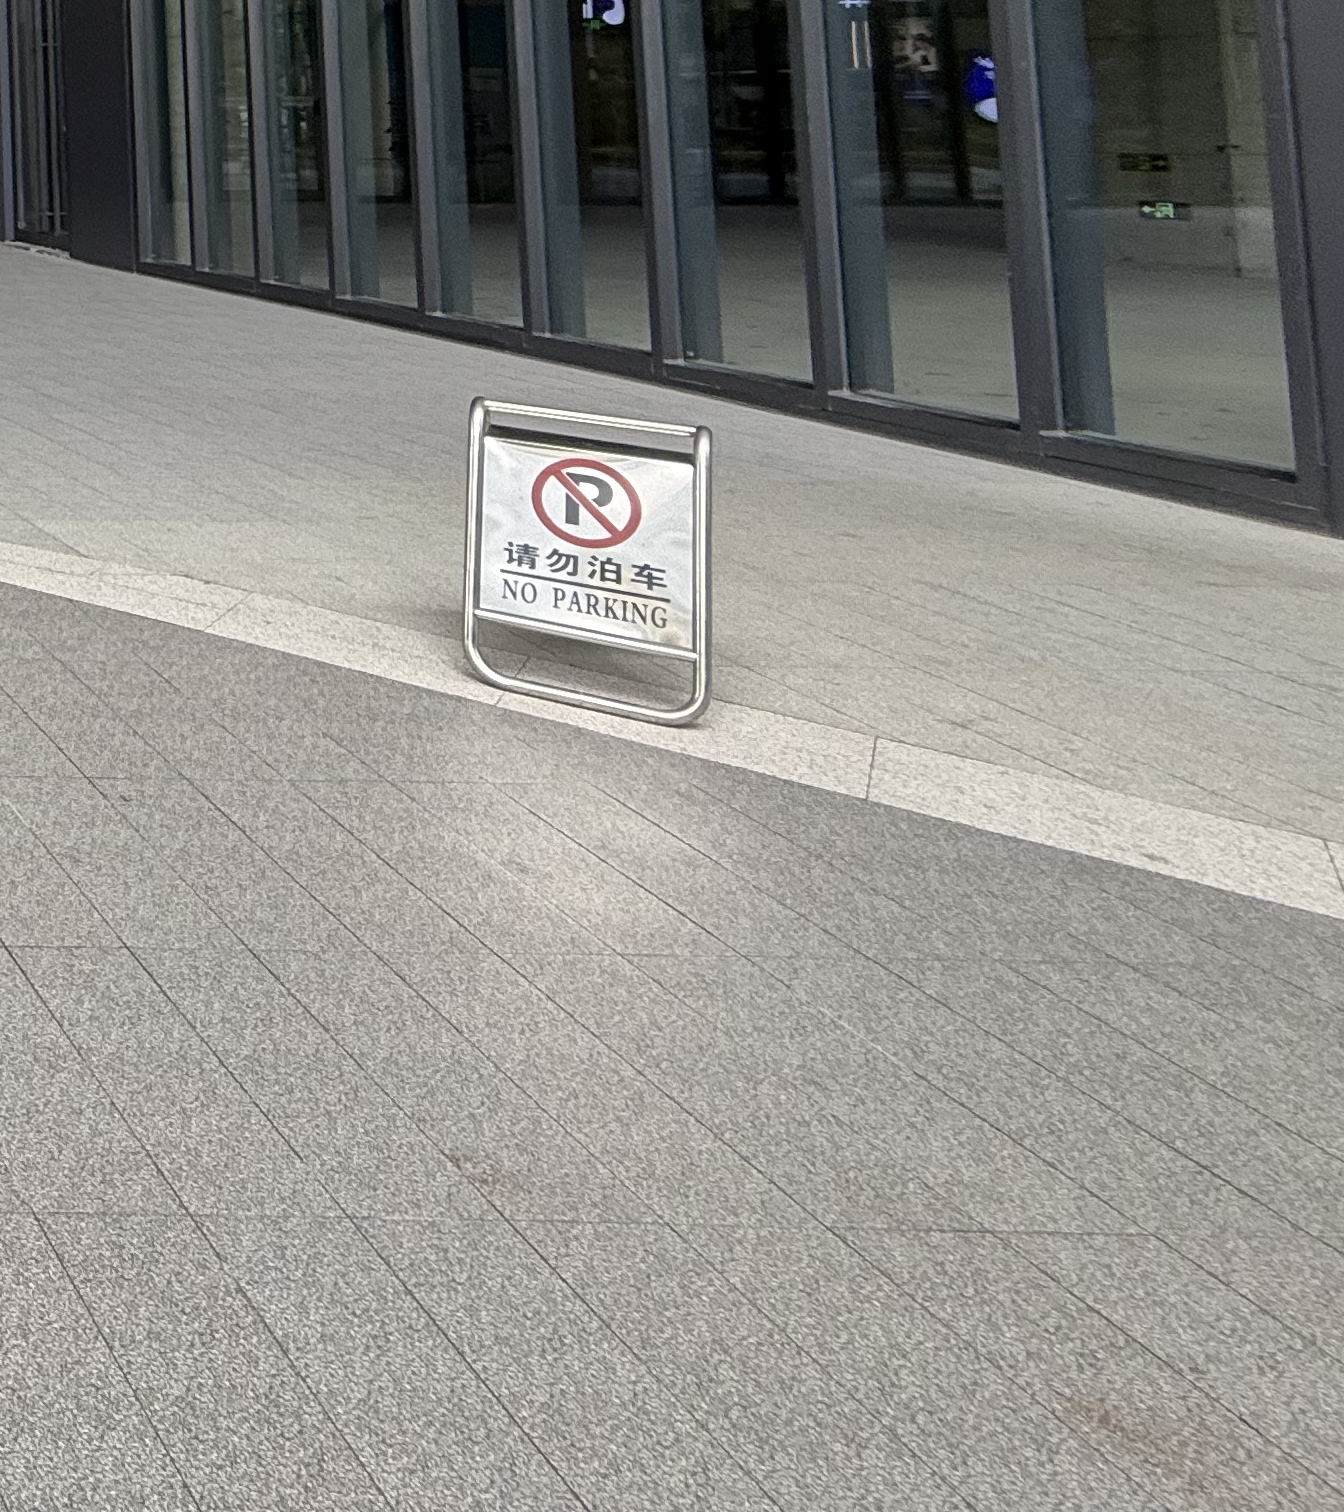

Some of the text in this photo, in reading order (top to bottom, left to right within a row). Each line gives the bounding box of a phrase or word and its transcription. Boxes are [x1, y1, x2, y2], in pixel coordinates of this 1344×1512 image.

[502, 541, 669, 592] 请勿泊车
[501, 577, 669, 629] NO PARKING
